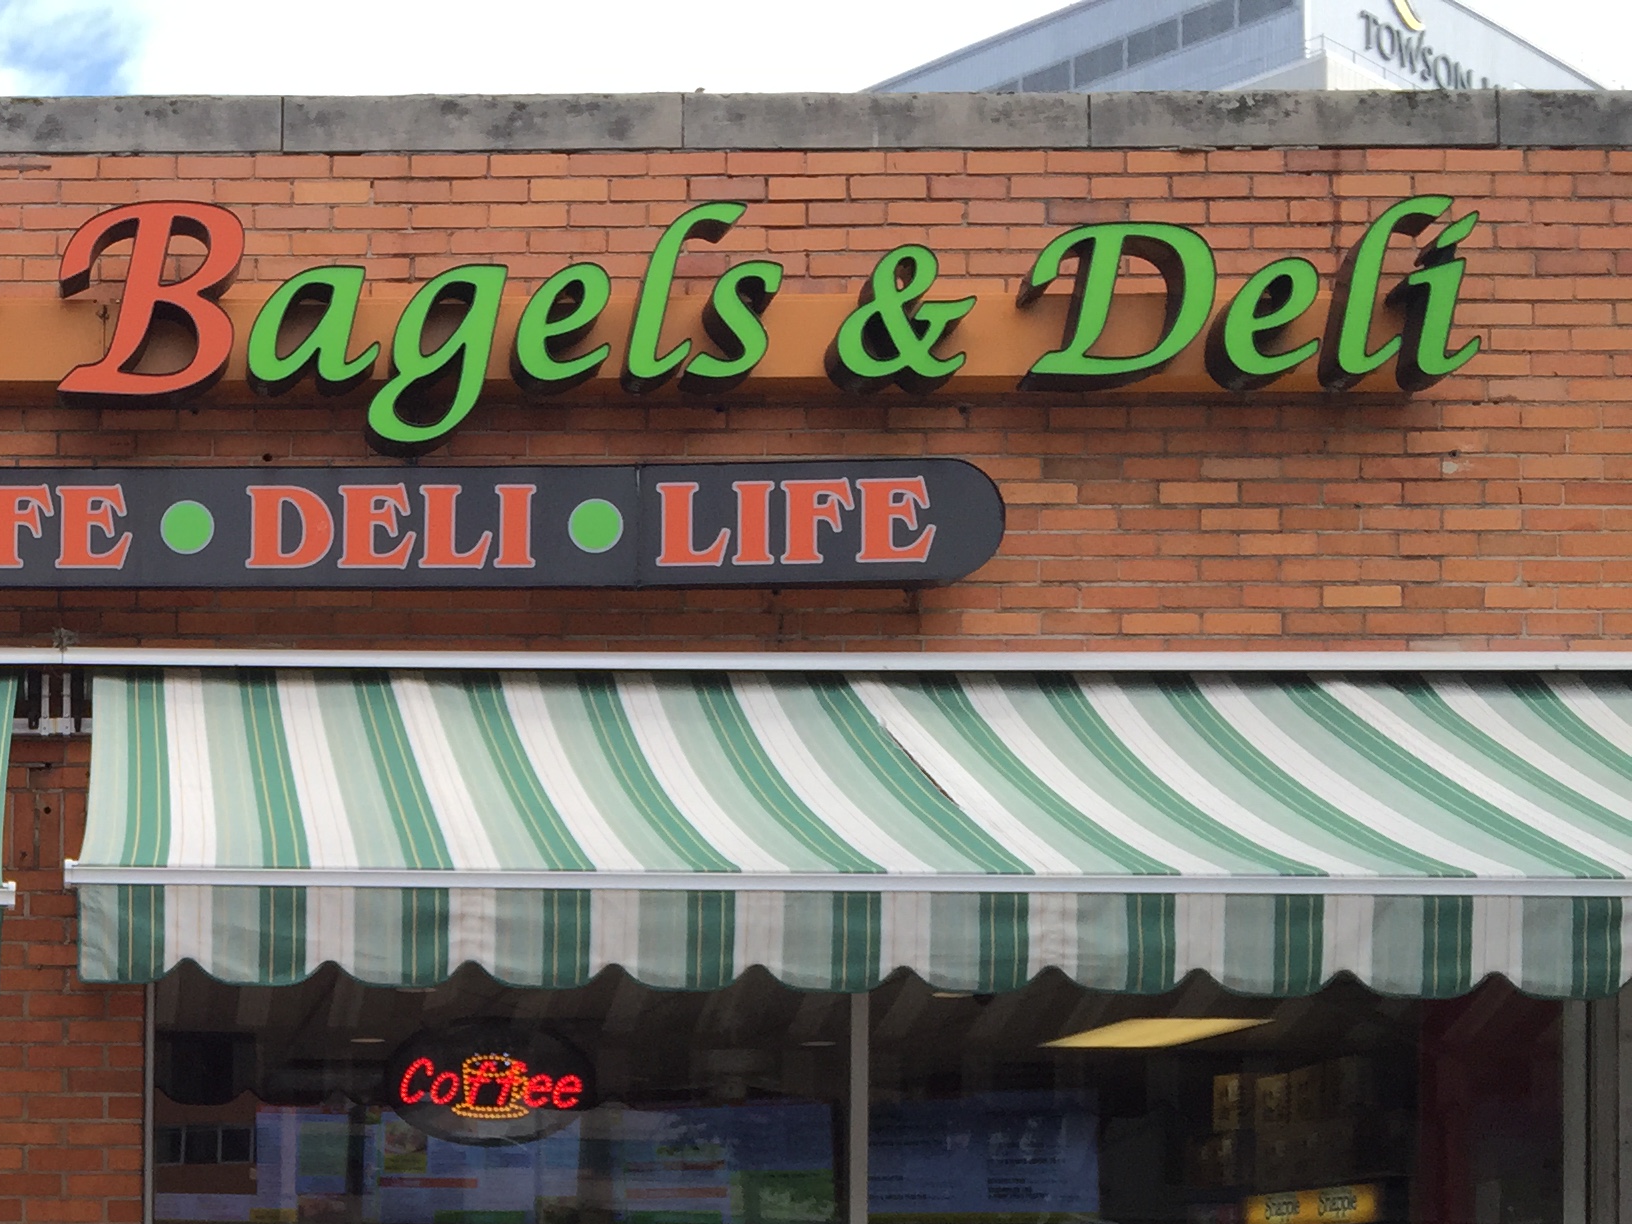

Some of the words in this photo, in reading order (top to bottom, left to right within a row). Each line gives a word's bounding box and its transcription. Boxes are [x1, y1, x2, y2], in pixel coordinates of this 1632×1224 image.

[1358, 9, 1474, 90] TOWSON
[56, 200, 783, 454] Bagels
[828, 243, 977, 391] &
[1018, 194, 1482, 391] Deli
[244, 482, 537, 571] DELI
[655, 475, 937, 568] LIFE
[400, 1056, 584, 1109] Coffee
